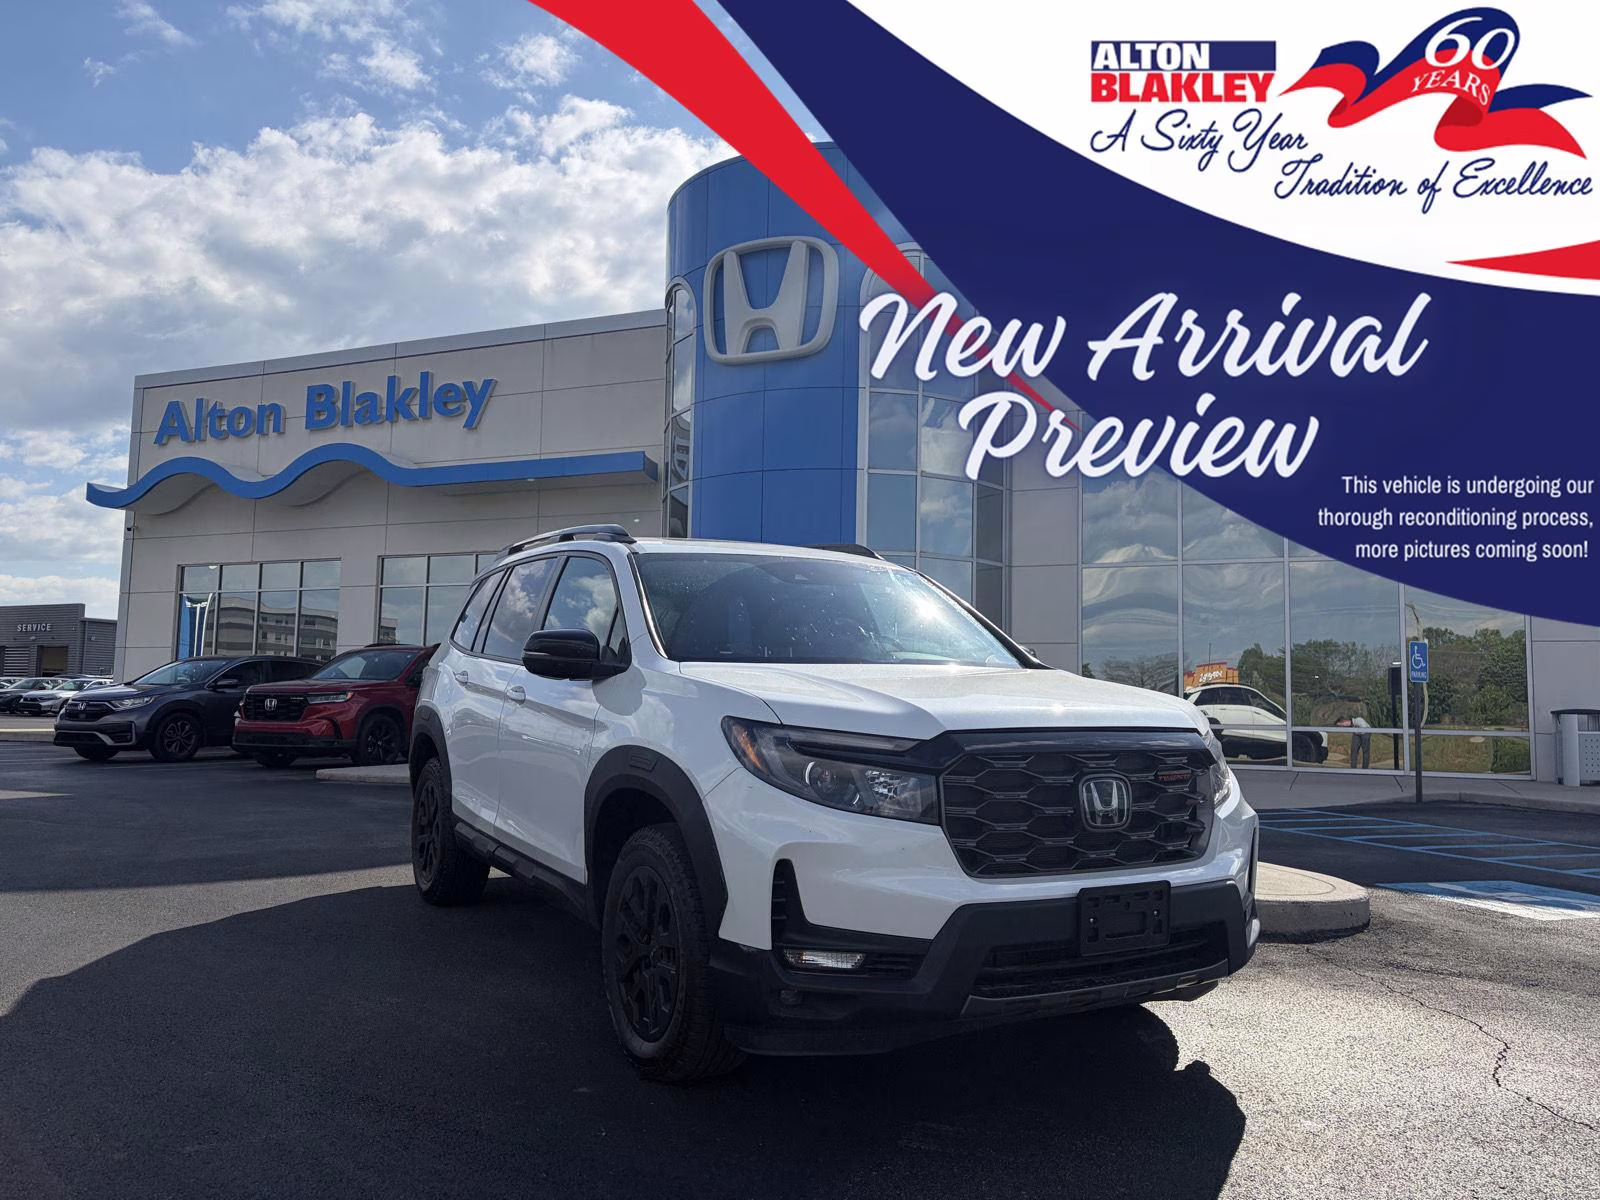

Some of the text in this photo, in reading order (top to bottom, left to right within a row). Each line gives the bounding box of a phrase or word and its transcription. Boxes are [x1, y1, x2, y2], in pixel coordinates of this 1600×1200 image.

[153, 371, 498, 445] Alton Blakley
[16, 623, 52, 632] SERVICE
